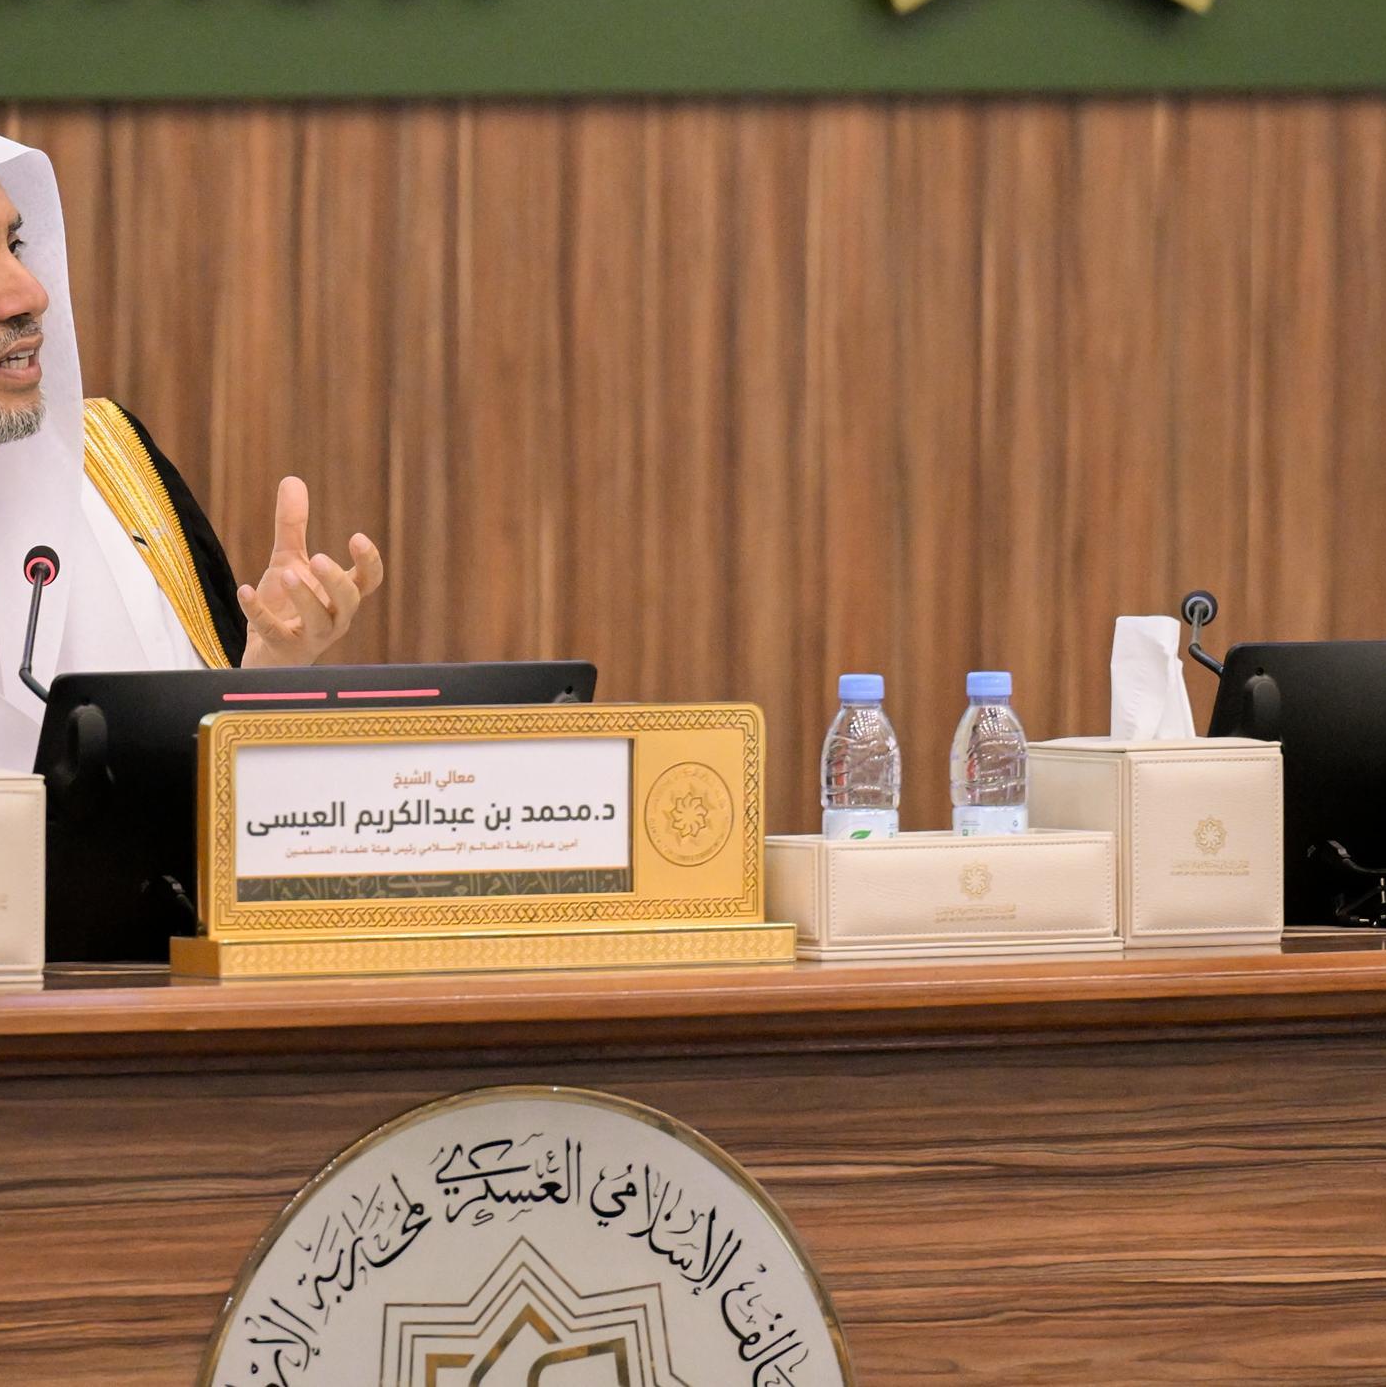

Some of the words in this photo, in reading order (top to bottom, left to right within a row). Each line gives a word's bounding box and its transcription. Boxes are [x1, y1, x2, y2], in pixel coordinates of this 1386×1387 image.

[392, 769, 432, 790] الشيخ
[435, 768, 476, 791] معالي
[246, 800, 346, 837] العيسى
[354, 798, 476, 834] عبدالكريم
[484, 801, 512, 831] بن
[521, 801, 616, 824] د.محمد
[429, 1133, 582, 1227] العسكري
